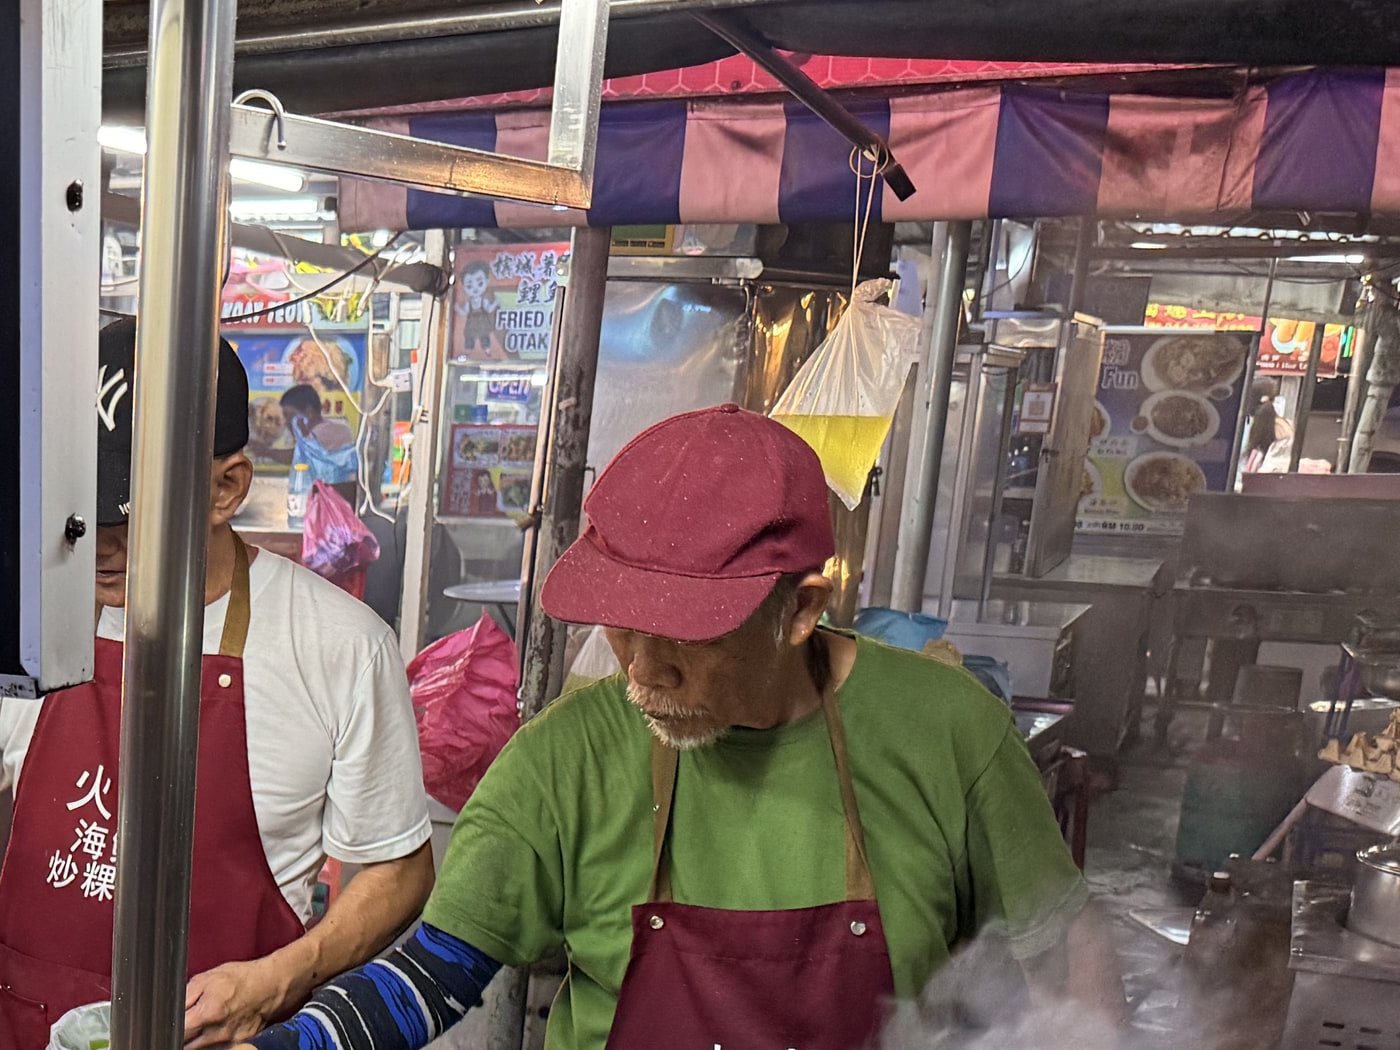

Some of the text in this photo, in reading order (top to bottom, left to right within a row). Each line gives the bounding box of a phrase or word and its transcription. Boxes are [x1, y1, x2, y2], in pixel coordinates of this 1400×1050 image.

[497, 311, 544, 329] FRIED
[507, 333, 548, 351] OTAK
[1102, 367, 1139, 389] Fun
[66, 765, 112, 820] 火
[46, 849, 117, 902] 炒粿
